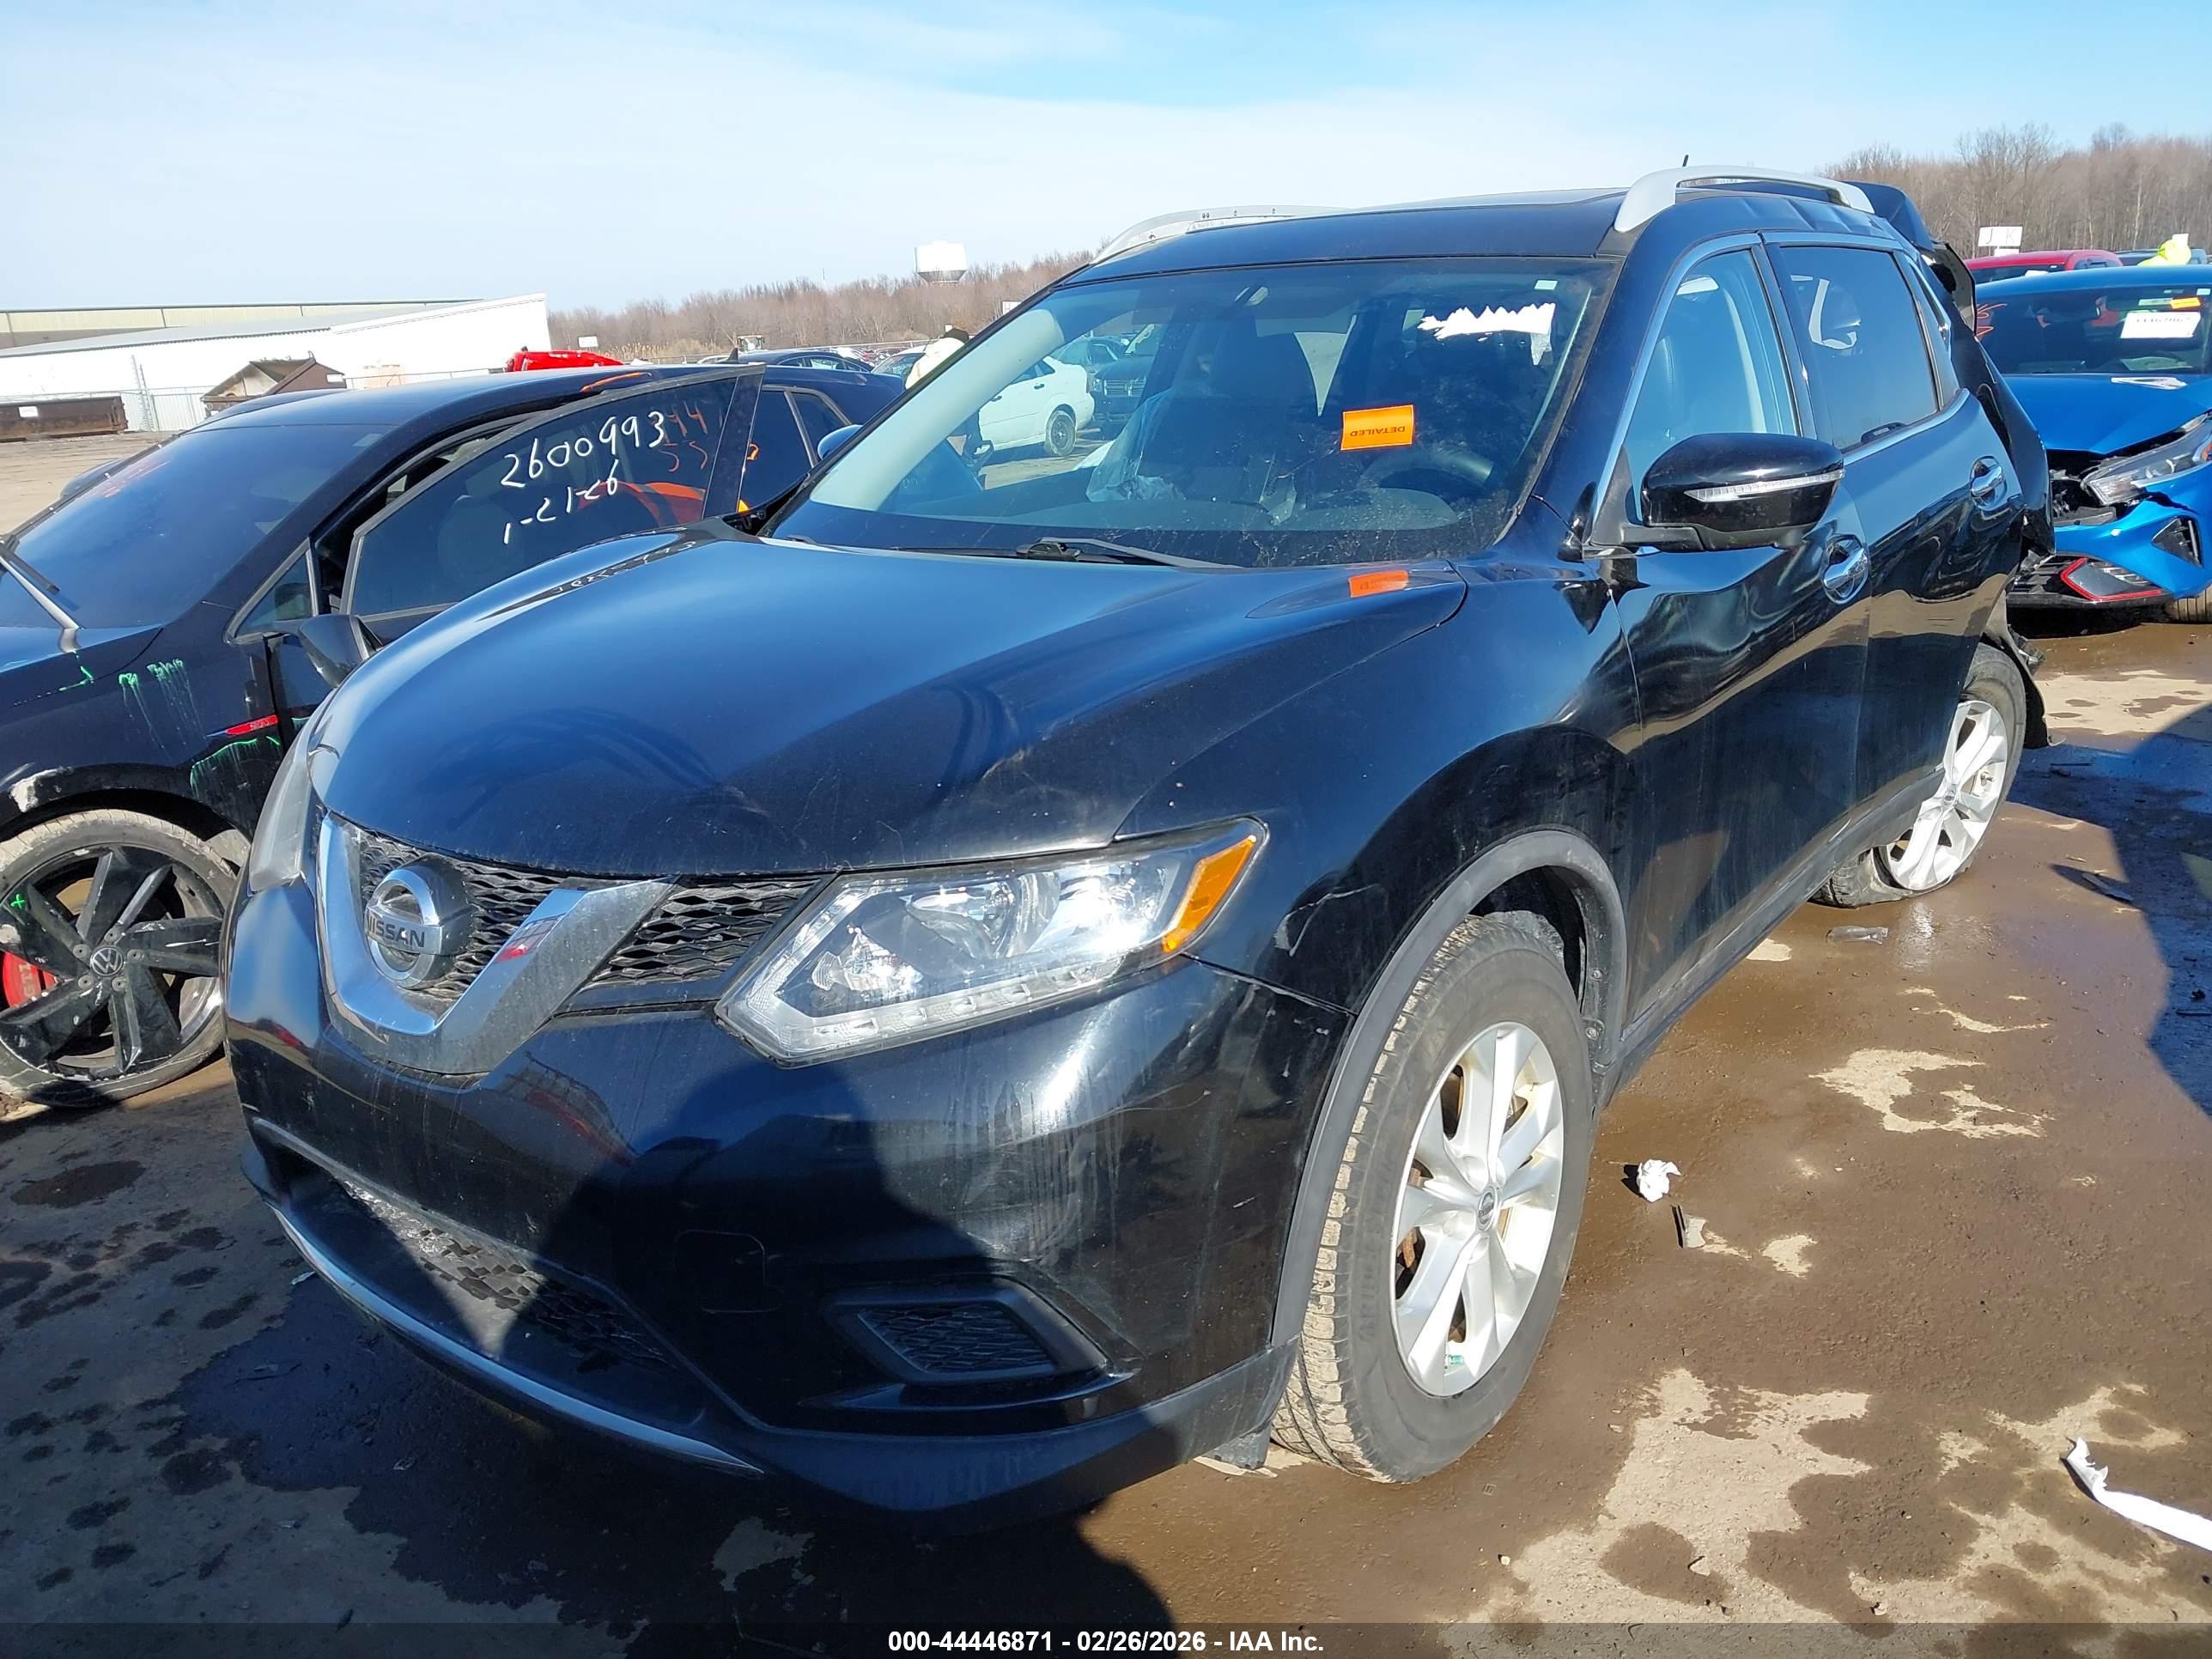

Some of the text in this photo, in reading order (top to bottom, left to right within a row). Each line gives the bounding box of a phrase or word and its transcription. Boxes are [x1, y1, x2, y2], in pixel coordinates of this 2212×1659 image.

[1349, 425, 1406, 437] DETAILED
[500, 410, 665, 488] 2600993
[366, 913, 425, 948] NISSAN
